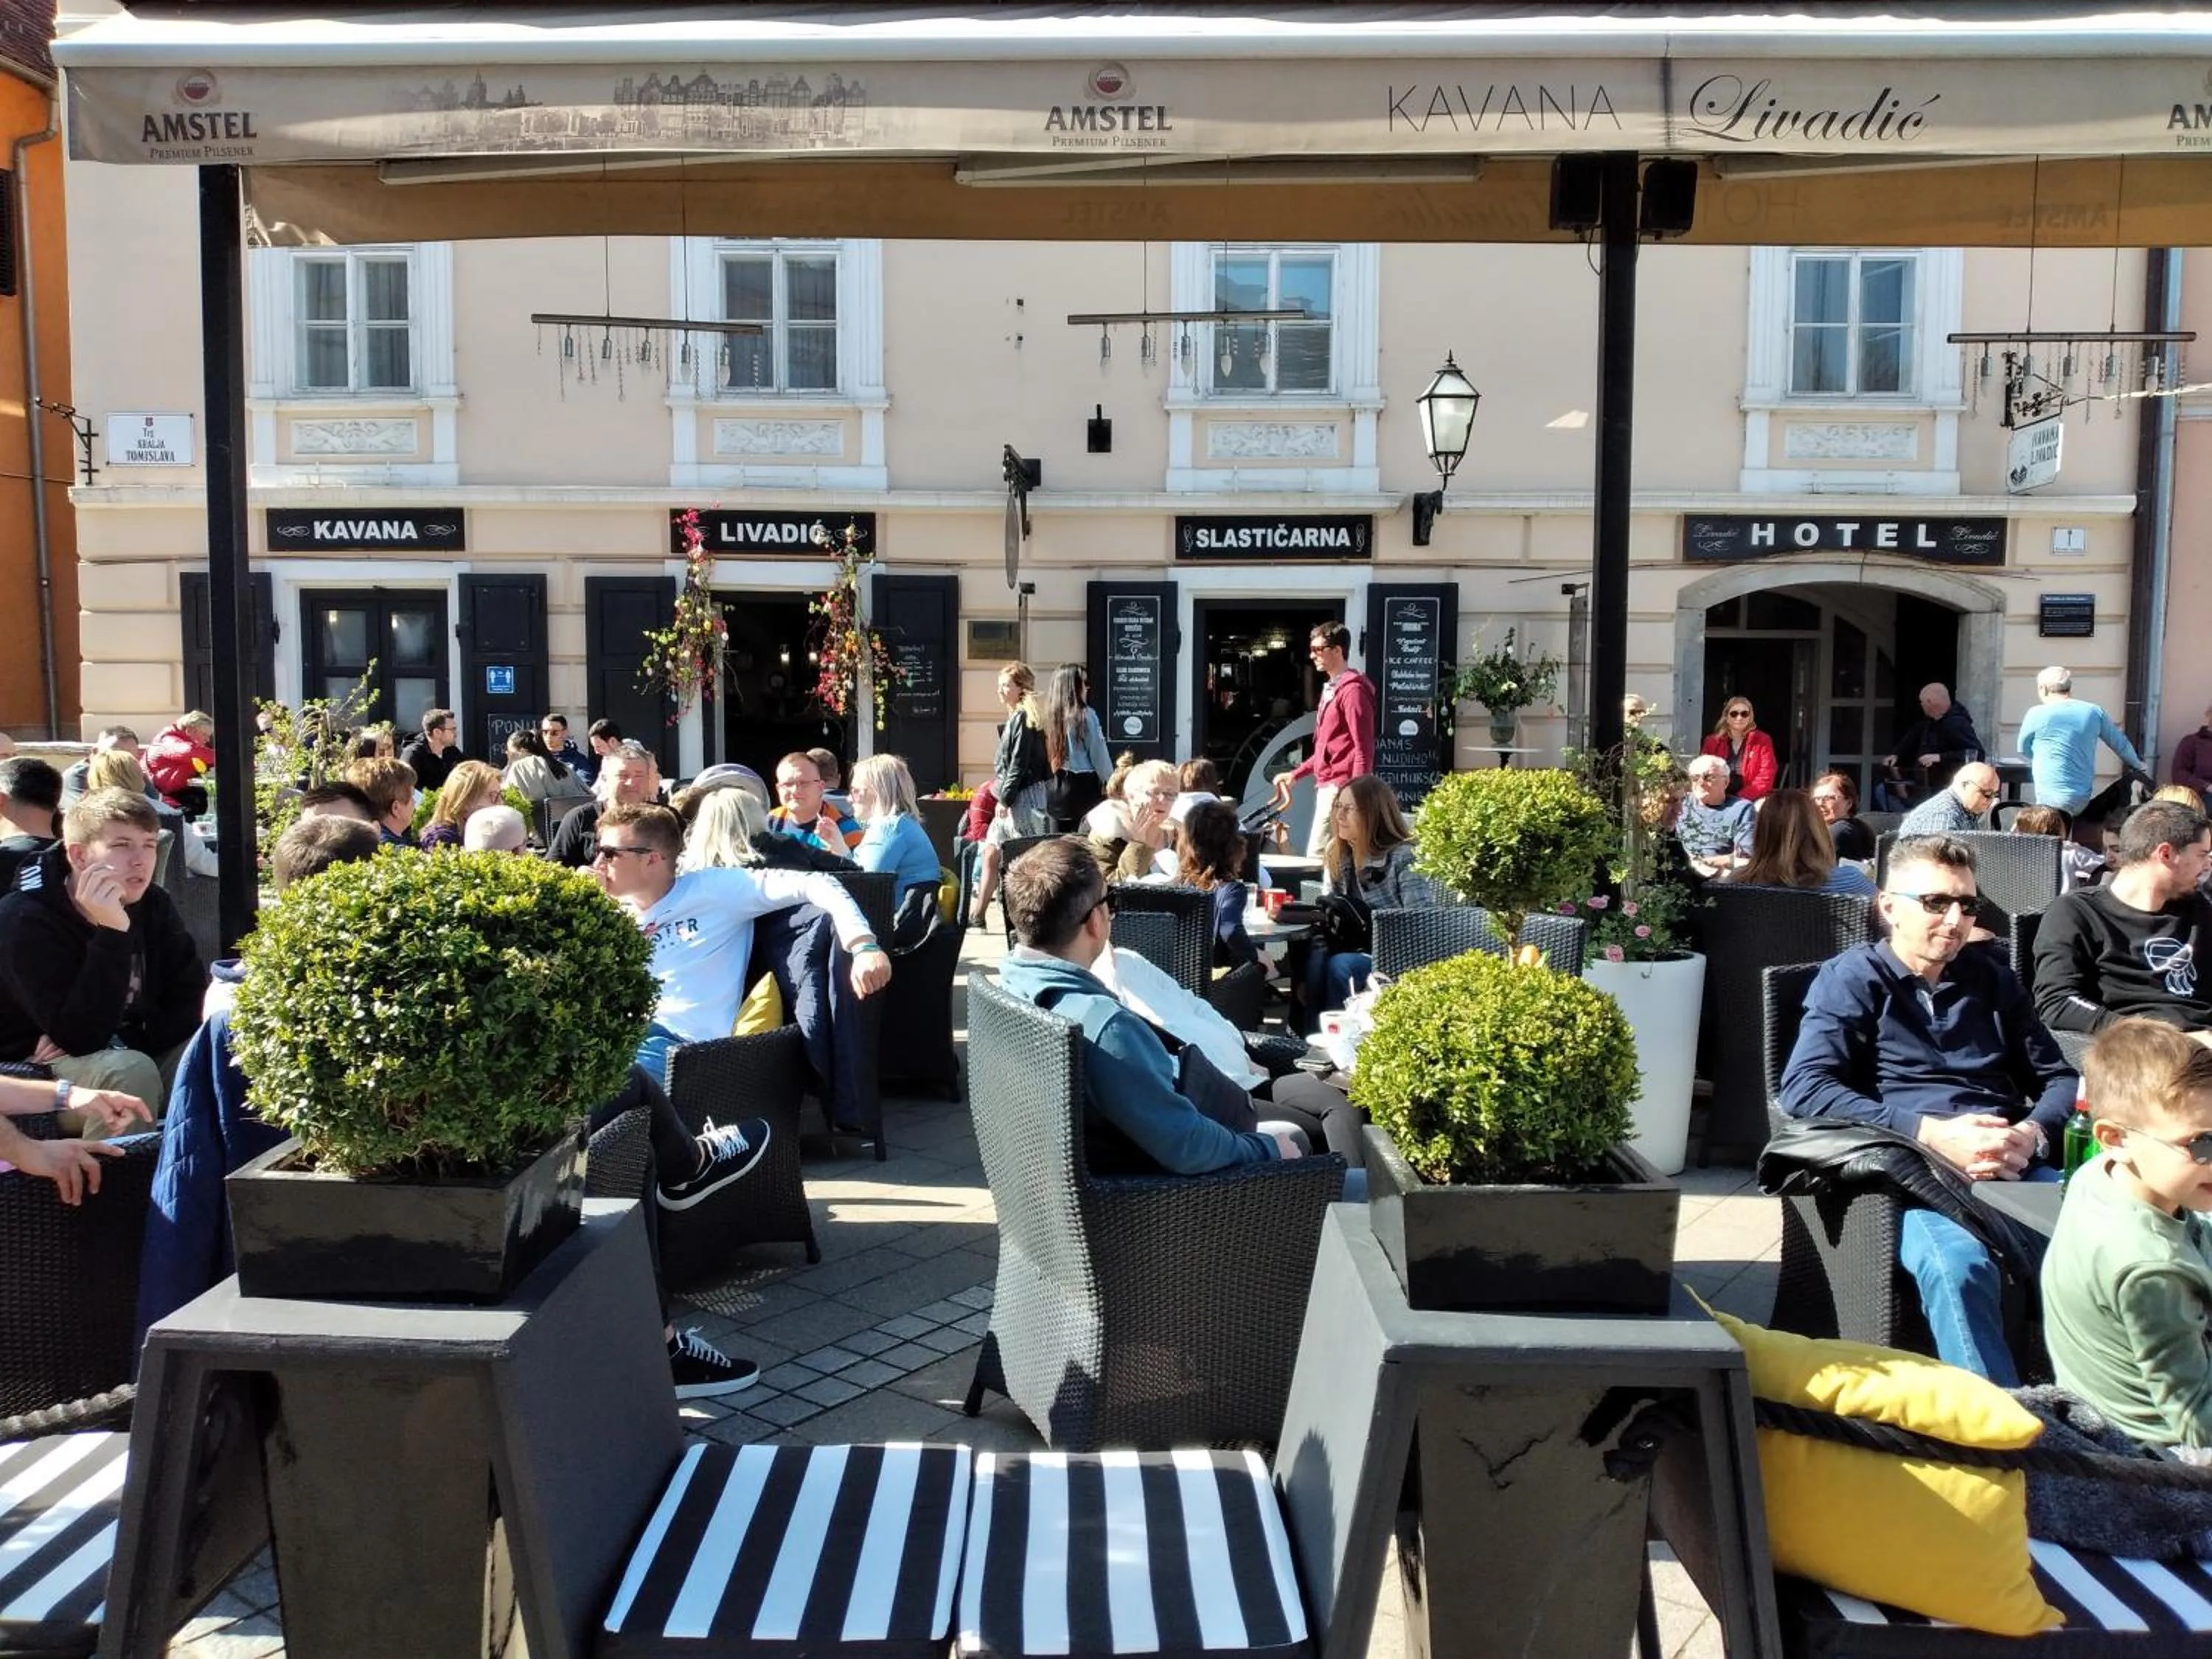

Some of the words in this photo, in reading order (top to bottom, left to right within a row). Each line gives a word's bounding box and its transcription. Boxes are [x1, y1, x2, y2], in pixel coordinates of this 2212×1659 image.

[1044, 105, 1172, 131] AMSTEL
[1388, 85, 1621, 132] KAVANA
[1679, 74, 1941, 143] Livadić
[142, 112, 257, 142] AMSTEL
[1052, 136, 1108, 147] PREMIUM
[1113, 136, 1167, 147] PILSENER
[125, 451, 175, 462] TOMISLAVA
[313, 521, 417, 539] KAVANA
[1196, 524, 1351, 548] SLASTIČARNA
[1751, 523, 1937, 547] HOTEL
